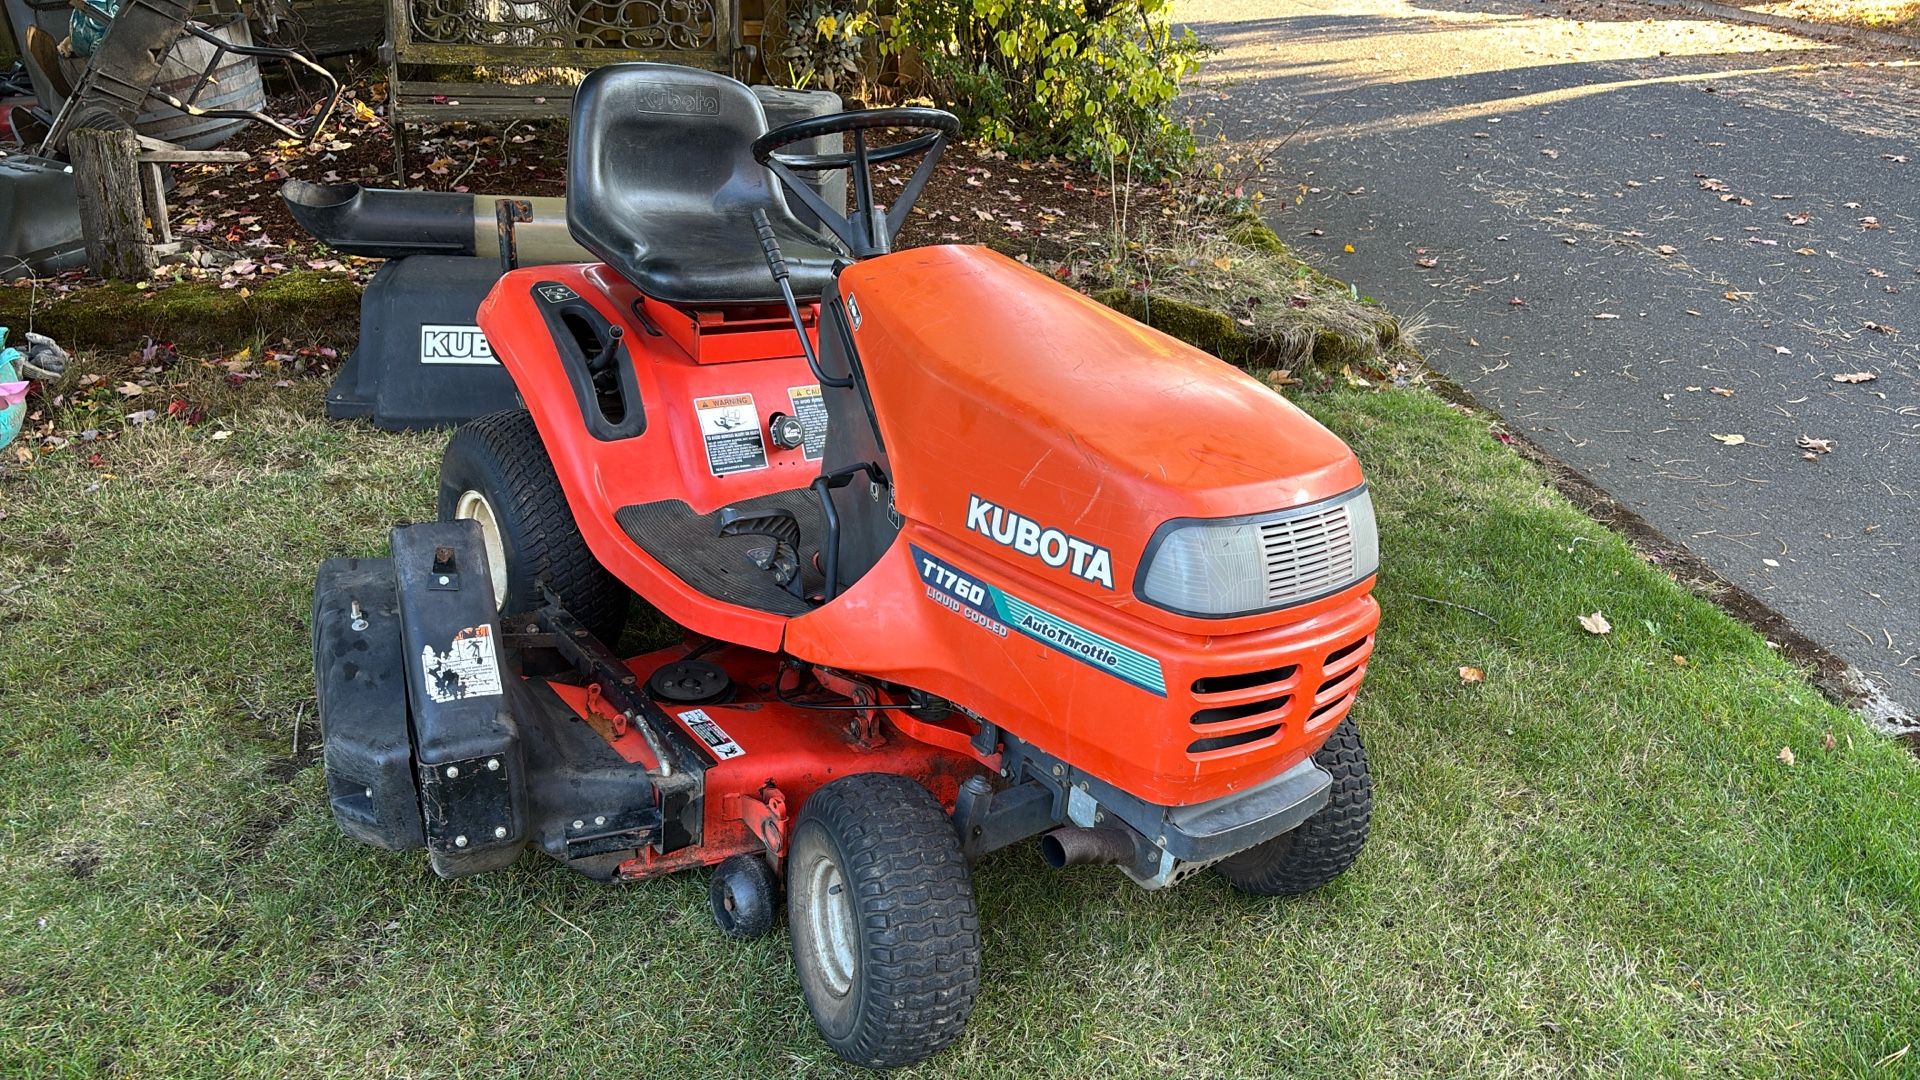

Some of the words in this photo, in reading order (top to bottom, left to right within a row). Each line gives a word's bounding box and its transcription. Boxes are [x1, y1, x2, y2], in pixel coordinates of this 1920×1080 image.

[712, 397, 748, 407] WARNING
[966, 492, 1115, 591] KUBOTA
[923, 558, 985, 606] T1760
[927, 586, 960, 613] LIQUID
[964, 607, 1008, 637] COOLED
[1021, 615, 1118, 666] AutoThrottle
